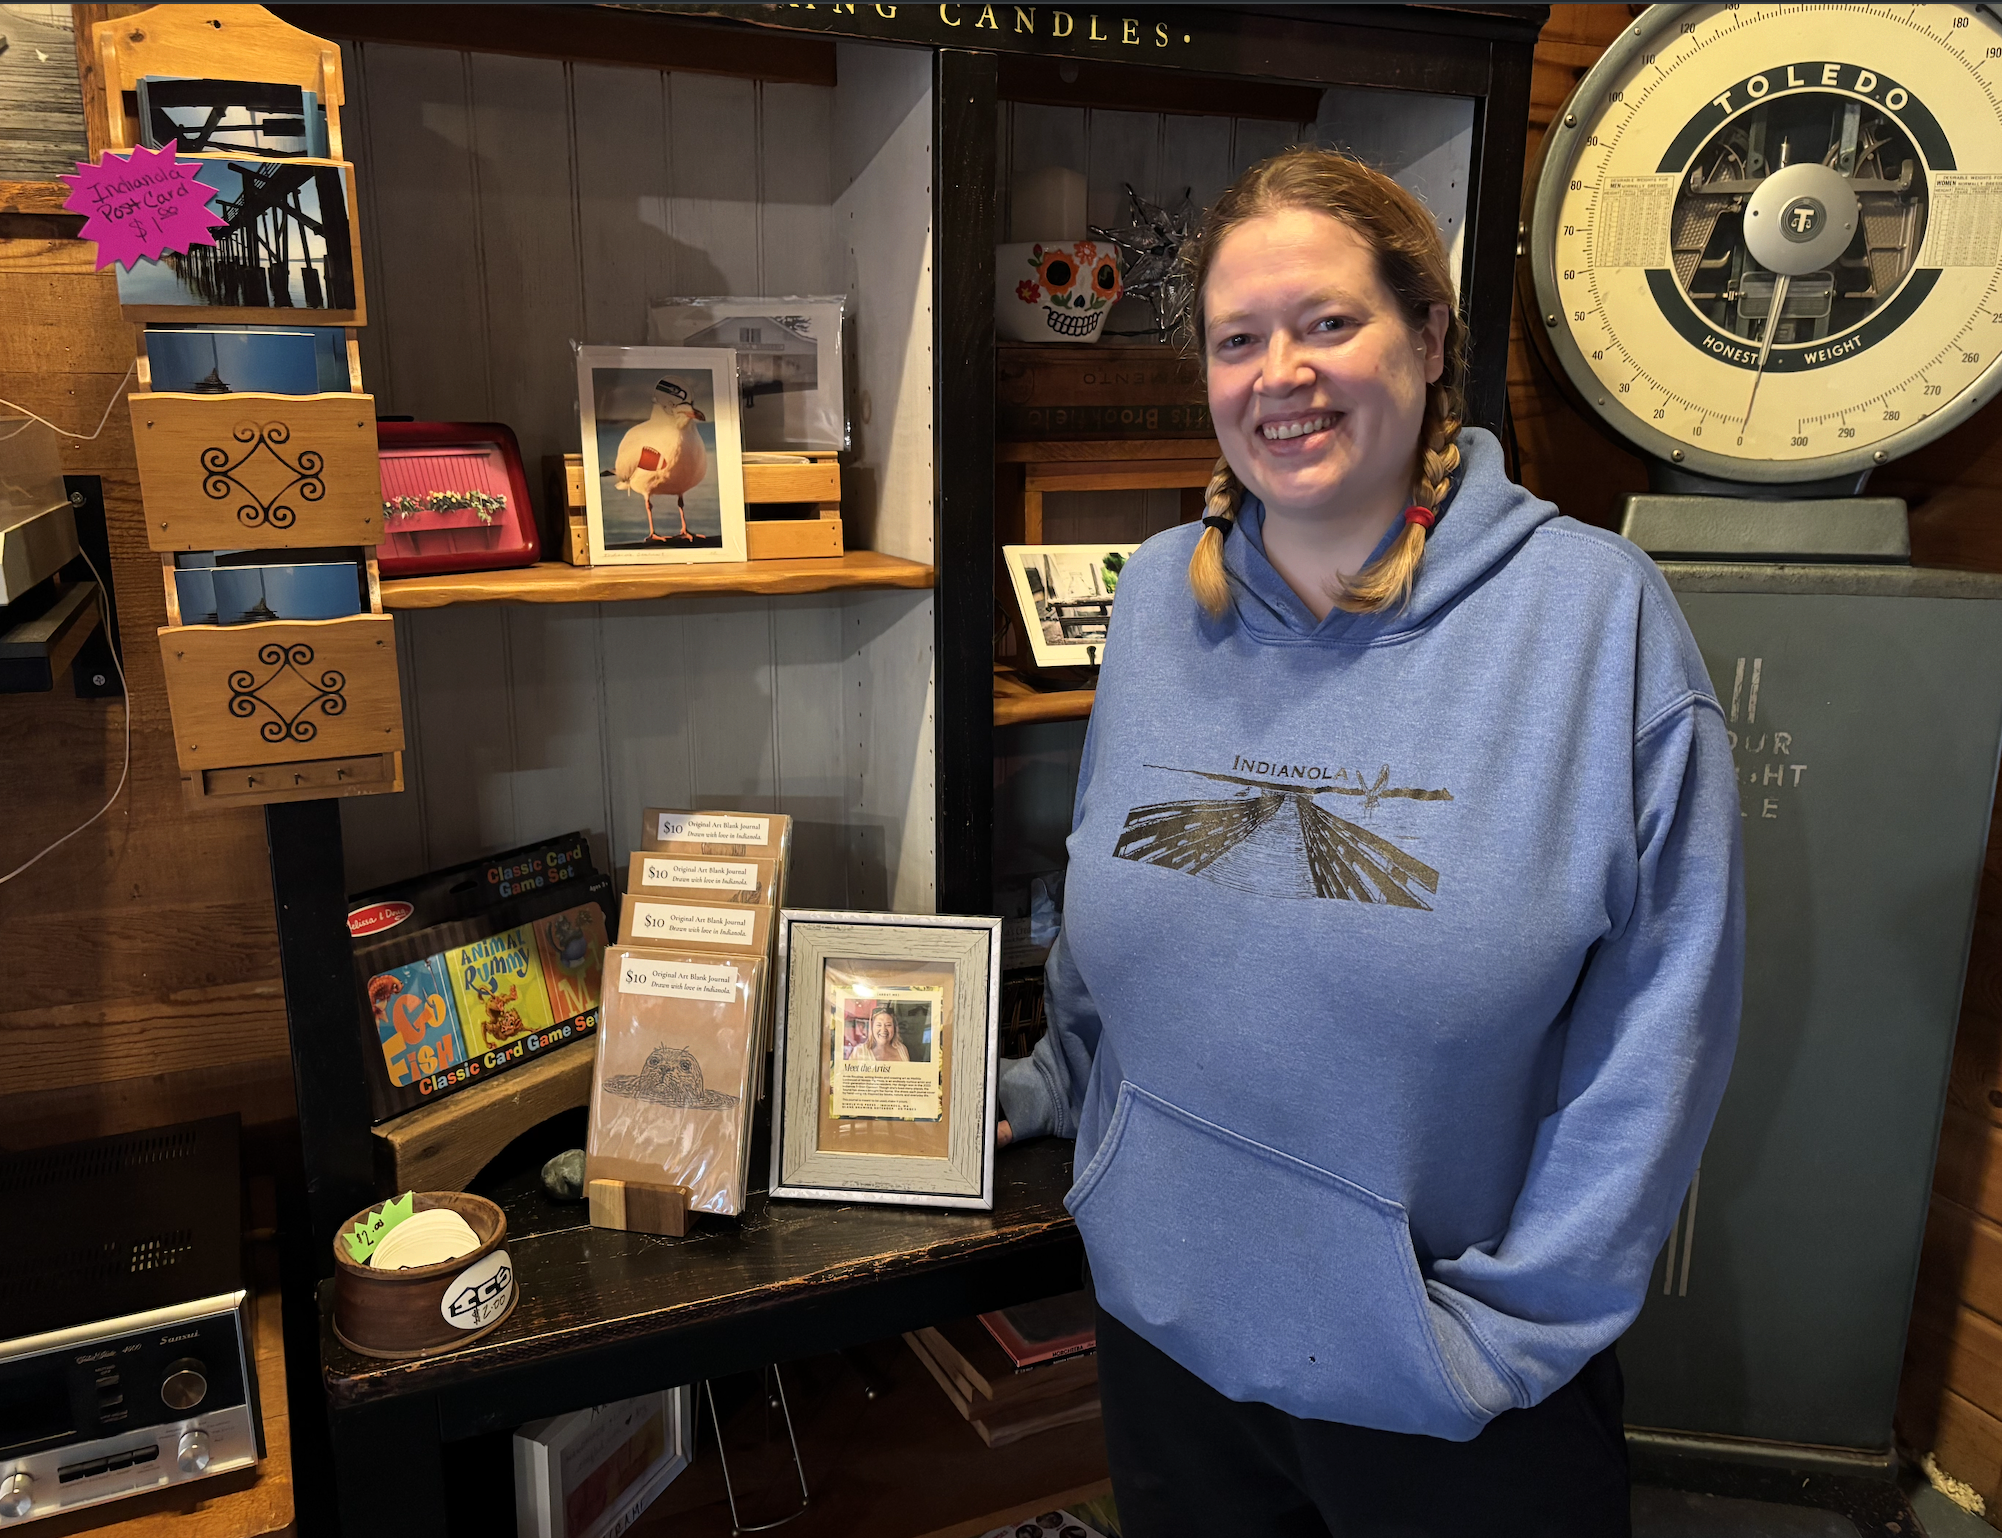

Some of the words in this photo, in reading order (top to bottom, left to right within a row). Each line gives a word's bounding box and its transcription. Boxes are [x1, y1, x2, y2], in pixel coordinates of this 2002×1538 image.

[1680, 22, 1696, 34] 120
[1952, 17, 1969, 29] 180
[1986, 46, 2002, 59] 190
[1641, 54, 1656, 65] 110
[1712, 63, 1909, 115] TOLEDO
[1608, 91, 1624, 103] 100
[1586, 136, 1598, 147] 90
[87, 166, 185, 204] Indianola
[1570, 180, 1582, 191] 80
[1563, 225, 1575, 236] 70
[1564, 269, 1575, 280] 60
[1574, 311, 1585, 321] 50
[1592, 350, 1603, 361] 40
[1702, 334, 1758, 365] HONEST
[1803, 335, 1863, 365] WEIGHT
[1961, 353, 1980, 363] 260
[1619, 383, 1630, 393] 30
[1923, 385, 1942, 396] 270
[1653, 409, 1665, 419] 20
[1882, 411, 1900, 421] 280
[1692, 426, 1702, 437] 10
[1838, 428, 1855, 438] 290
[1736, 436, 1743, 446] 0
[1790, 437, 1808, 447] 300
[1231, 754, 1349, 782] INDIANOLA
[663, 820, 683, 835] $10
[688, 821, 711, 829] Original
[739, 823, 761, 831] Journal
[706, 830, 717, 838] with
[736, 832, 762, 840] Indianola.
[487, 858, 542, 884] Classic
[546, 844, 582, 867] Card
[648, 865, 669, 880] $10
[673, 865, 697, 874] Original
[697, 866, 708, 874] Art
[709, 867, 725, 875] Blank
[726, 868, 747, 876] Journal
[499, 875, 544, 898] Game
[548, 865, 575, 883] Set
[704, 876, 714, 884] love
[721, 877, 748, 886] Indianola.
[644, 913, 665, 928] $10
[670, 914, 694, 924] Original
[707, 916, 723, 925] Blank
[724, 918, 746, 927] Journal
[669, 924, 687, 932] Drawn
[688, 925, 700, 933] with
[701, 926, 711, 934] love
[720, 928, 747, 937] Indianola.
[625, 969, 647, 984] $10
[652, 970, 677, 979] Original
[677, 971, 688, 979] Art
[690, 972, 707, 981] Blank
[707, 973, 730, 984] Journal
[651, 980, 670, 989] Drawn
[670, 981, 683, 990] with
[683, 982, 695, 991] love
[696, 984, 702, 992] in
[703, 984, 731, 994] Indianola.
[392, 993, 447, 1045] Go
[419, 1061, 480, 1096] Classic
[483, 1040, 524, 1069] Card
[527, 1024, 572, 1052] Game
[574, 1011, 598, 1032] Set
[843, 1063, 859, 1072] Meet
[860, 1064, 871, 1073] the
[871, 1064, 891, 1074] Artist
[472, 1294, 506, 1325] $2.00
[159, 1329, 200, 1346] Sansui
